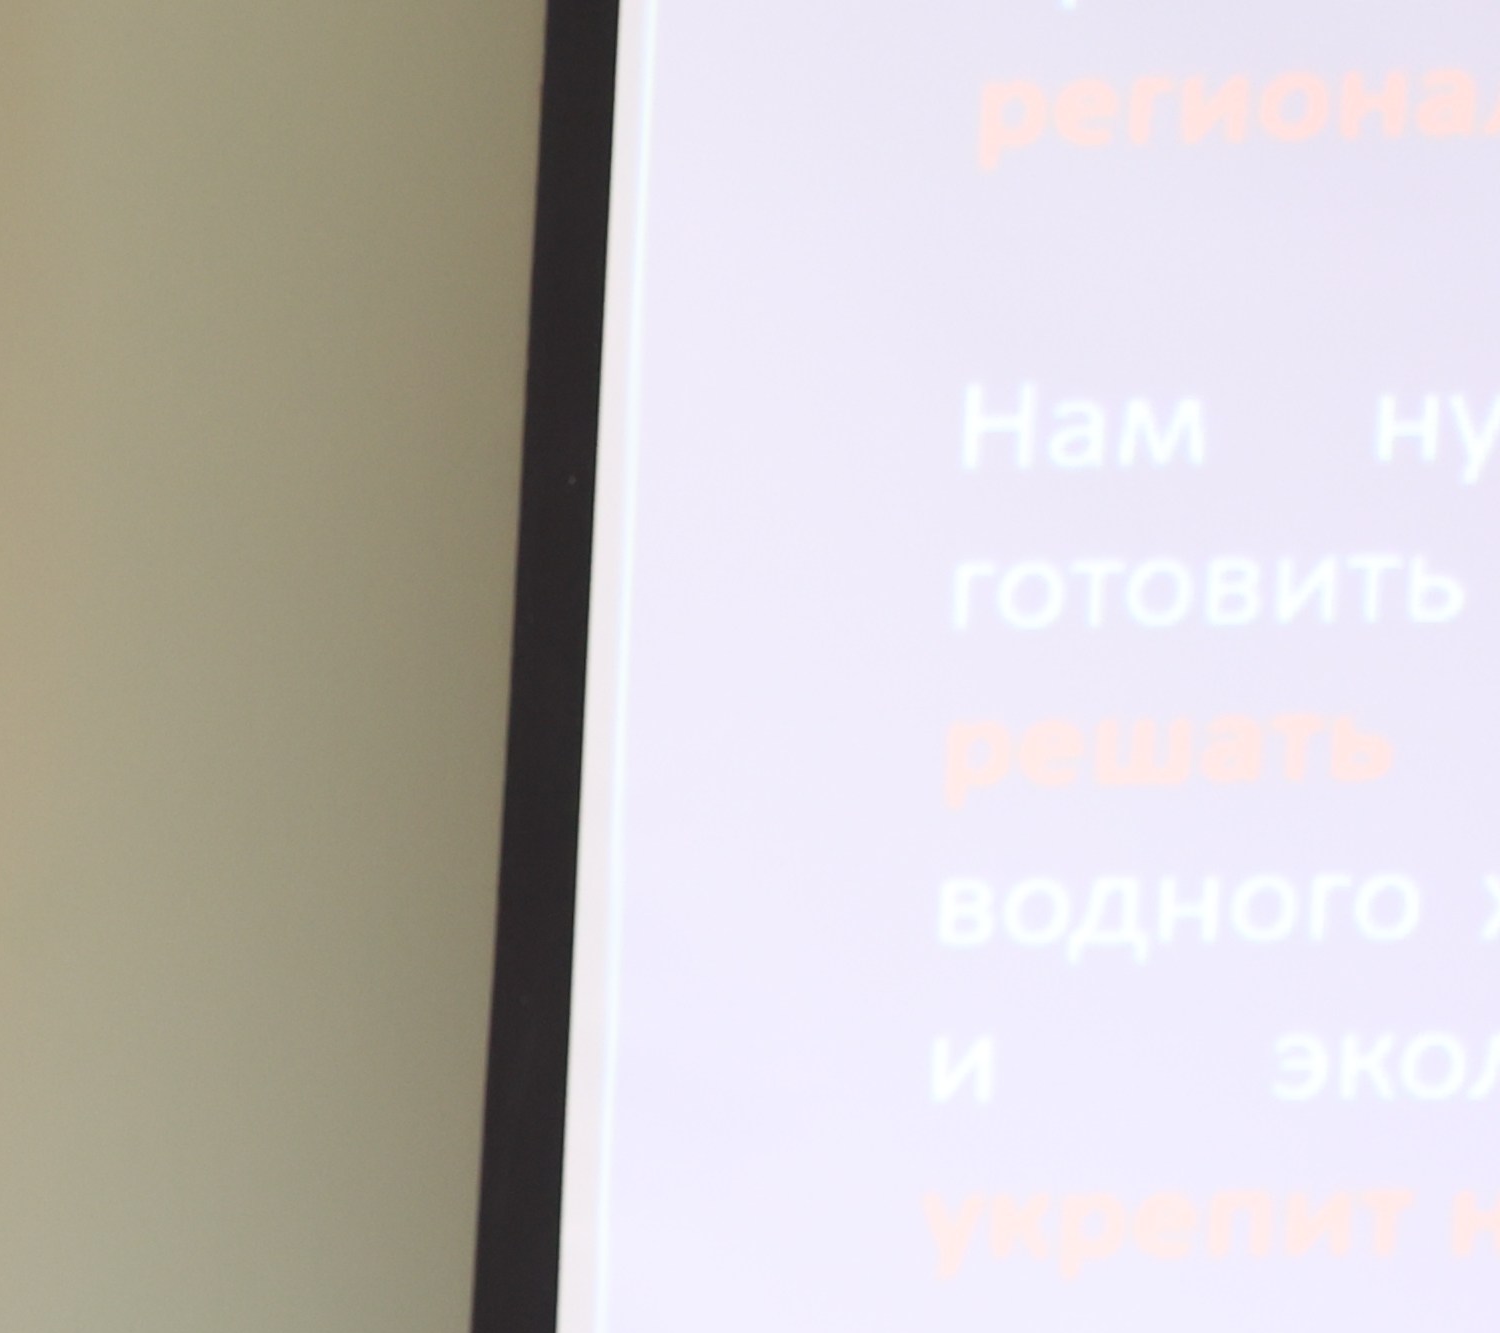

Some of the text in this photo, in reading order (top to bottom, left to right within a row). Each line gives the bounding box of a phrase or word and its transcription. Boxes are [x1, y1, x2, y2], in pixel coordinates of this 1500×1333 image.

[962, 382, 1209, 472] Нам
[951, 553, 1469, 632] готовить
[943, 712, 1396, 812] решать
[936, 872, 1424, 967] водного
[929, 1035, 998, 1106] и
[921, 1188, 1418, 1281] укрепит
